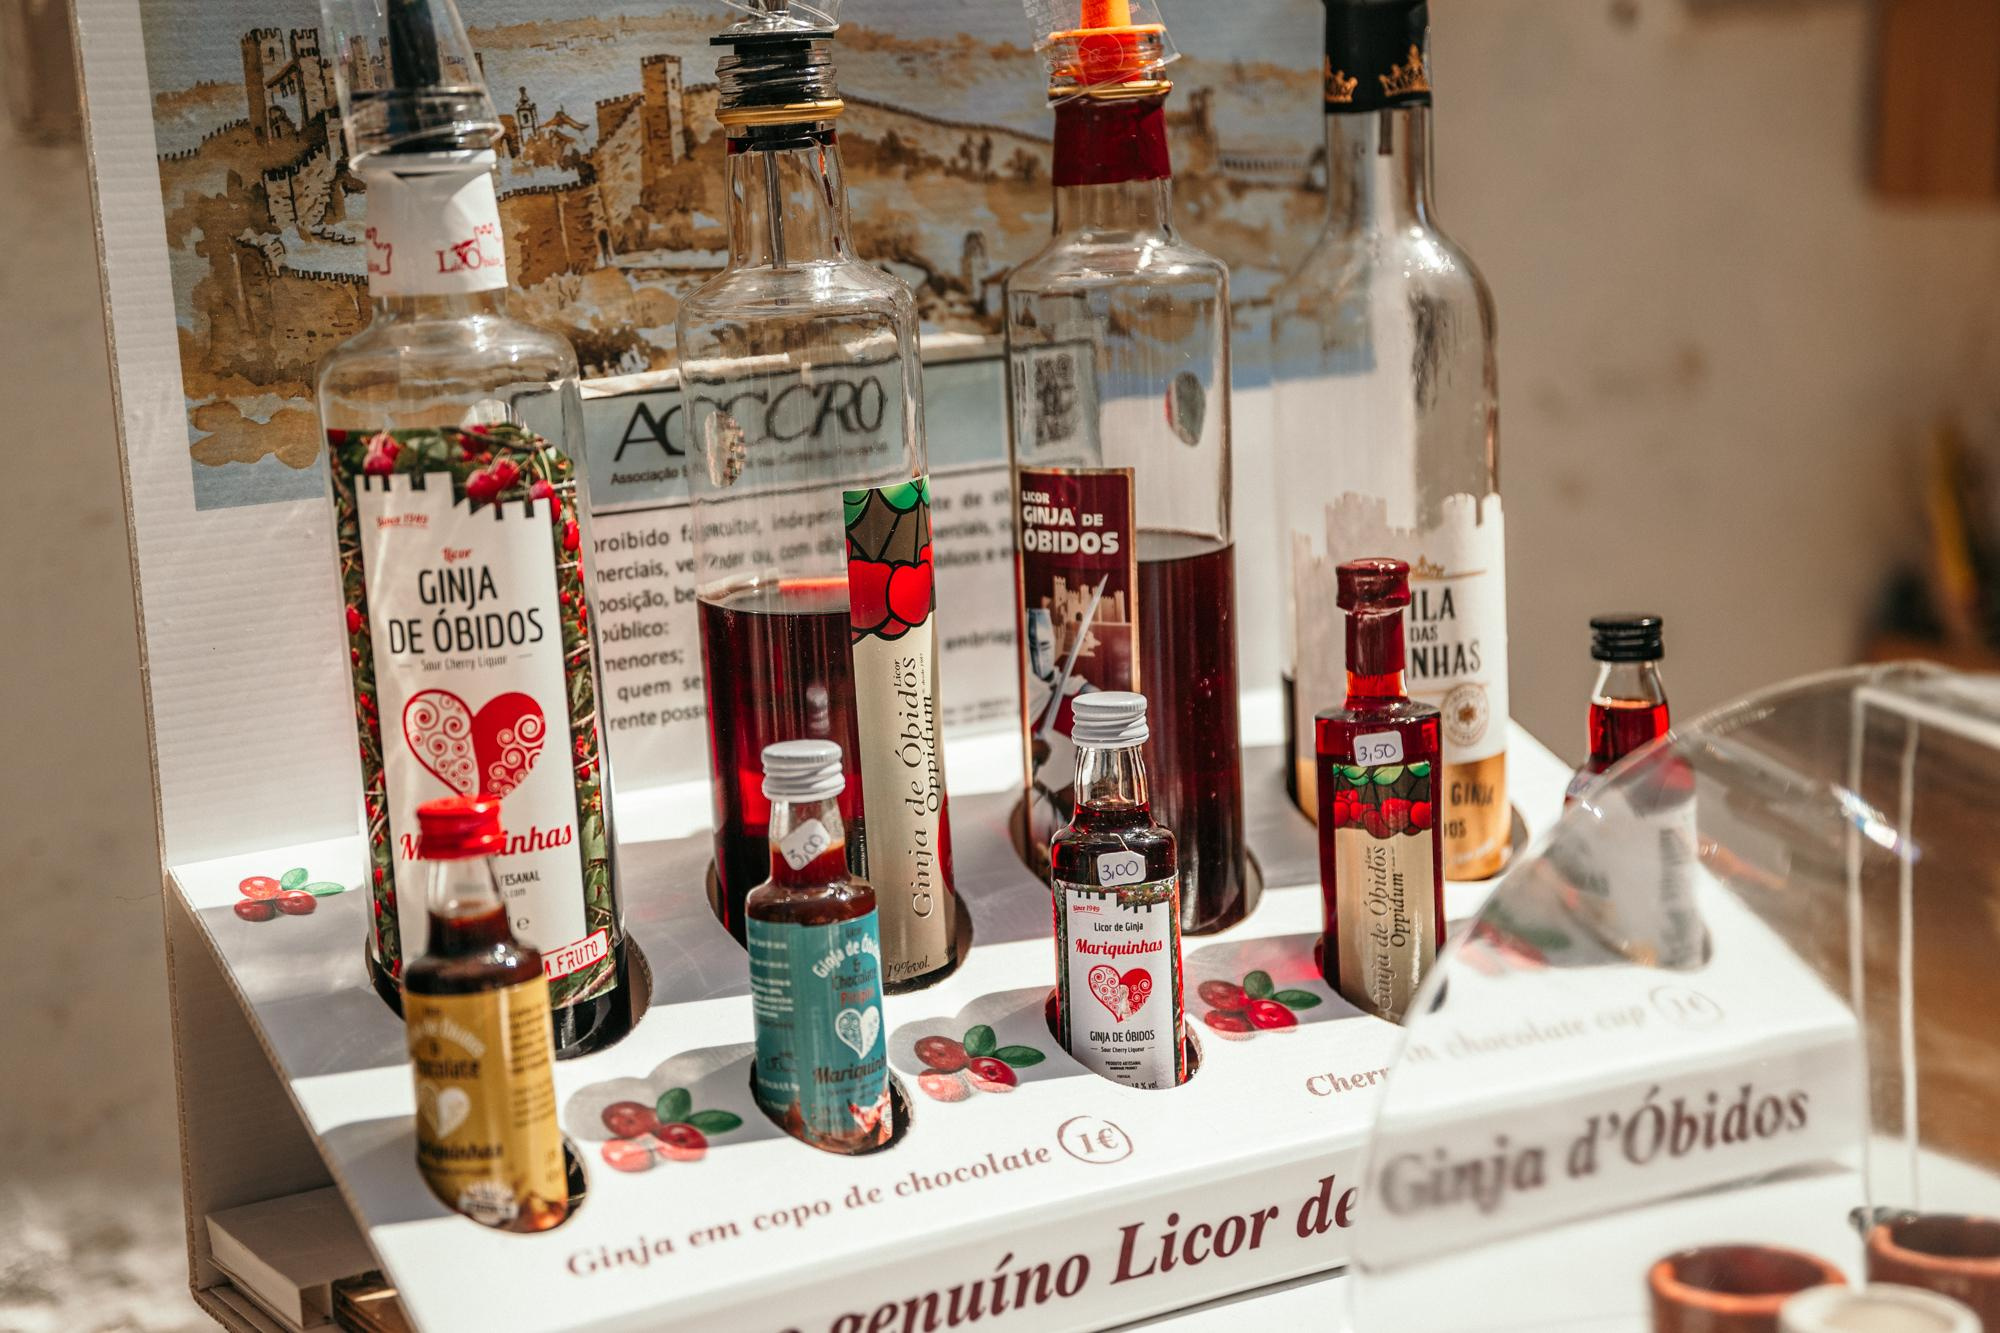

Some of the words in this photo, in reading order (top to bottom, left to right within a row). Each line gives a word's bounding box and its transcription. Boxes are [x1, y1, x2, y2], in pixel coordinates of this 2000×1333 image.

[611, 466, 679, 486] Associação
[1022, 490, 1050, 504] LICOR
[1023, 505, 1077, 526] GINJA
[1082, 513, 1104, 527] DE
[594, 528, 670, 554] roibido
[597, 559, 670, 585] merciais,
[418, 565, 498, 612] GINJA
[598, 589, 670, 615] posição,
[1410, 587, 1457, 622] ILA
[388, 618, 425, 656] DE
[432, 607, 544, 654] ÓBIDOS
[1409, 625, 1438, 642] DAS
[420, 658, 441, 672] Sour
[444, 656, 475, 672] Cherry
[1410, 638, 1482, 680] NHAS
[893, 659, 902, 687] Licor
[617, 680, 672, 704] quem
[894, 656, 924, 769] Óbidos
[922, 693, 942, 813] Oppidum
[1357, 742, 1397, 763] 3,50
[904, 780, 926, 817] de
[400, 823, 573, 861] Minhas
[501, 870, 540, 887] TESANAL
[911, 828, 934, 920] Ginja
[1100, 860, 1139, 881] 3,00
[1362, 846, 1388, 919] Óbidos
[1390, 872, 1411, 949] Oppidum
[1094, 922, 1112, 932] Licor
[1114, 922, 1124, 932] de
[1125, 921, 1144, 933] Ginja
[1370, 926, 1389, 949] de
[845, 939, 861, 957] de
[1075, 938, 1163, 960] Mariquinhas
[1090, 1030, 1111, 1044] GINJA
[1112, 1031, 1124, 1042] DE
[1125, 1029, 1155, 1042] ÓBIDOS
[1112, 1046, 1127, 1054] Cherry
[1127, 1046, 1145, 1054] Liqueur
[1305, 1066, 1390, 1097] Cherr
[1449, 1016, 1587, 1059] chocolate
[1598, 1003, 1647, 1030] cup
[566, 1234, 676, 1279] Ginja
[687, 1218, 740, 1248] em
[752, 1198, 832, 1233] copo
[843, 1184, 882, 1211] de
[894, 1144, 1053, 1199] chocolate
[1078, 1126, 1120, 1156] 1€
[1109, 1205, 1279, 1286] Licor
[1295, 1173, 1360, 1239] de
[1379, 1146, 1546, 1216] Ginja
